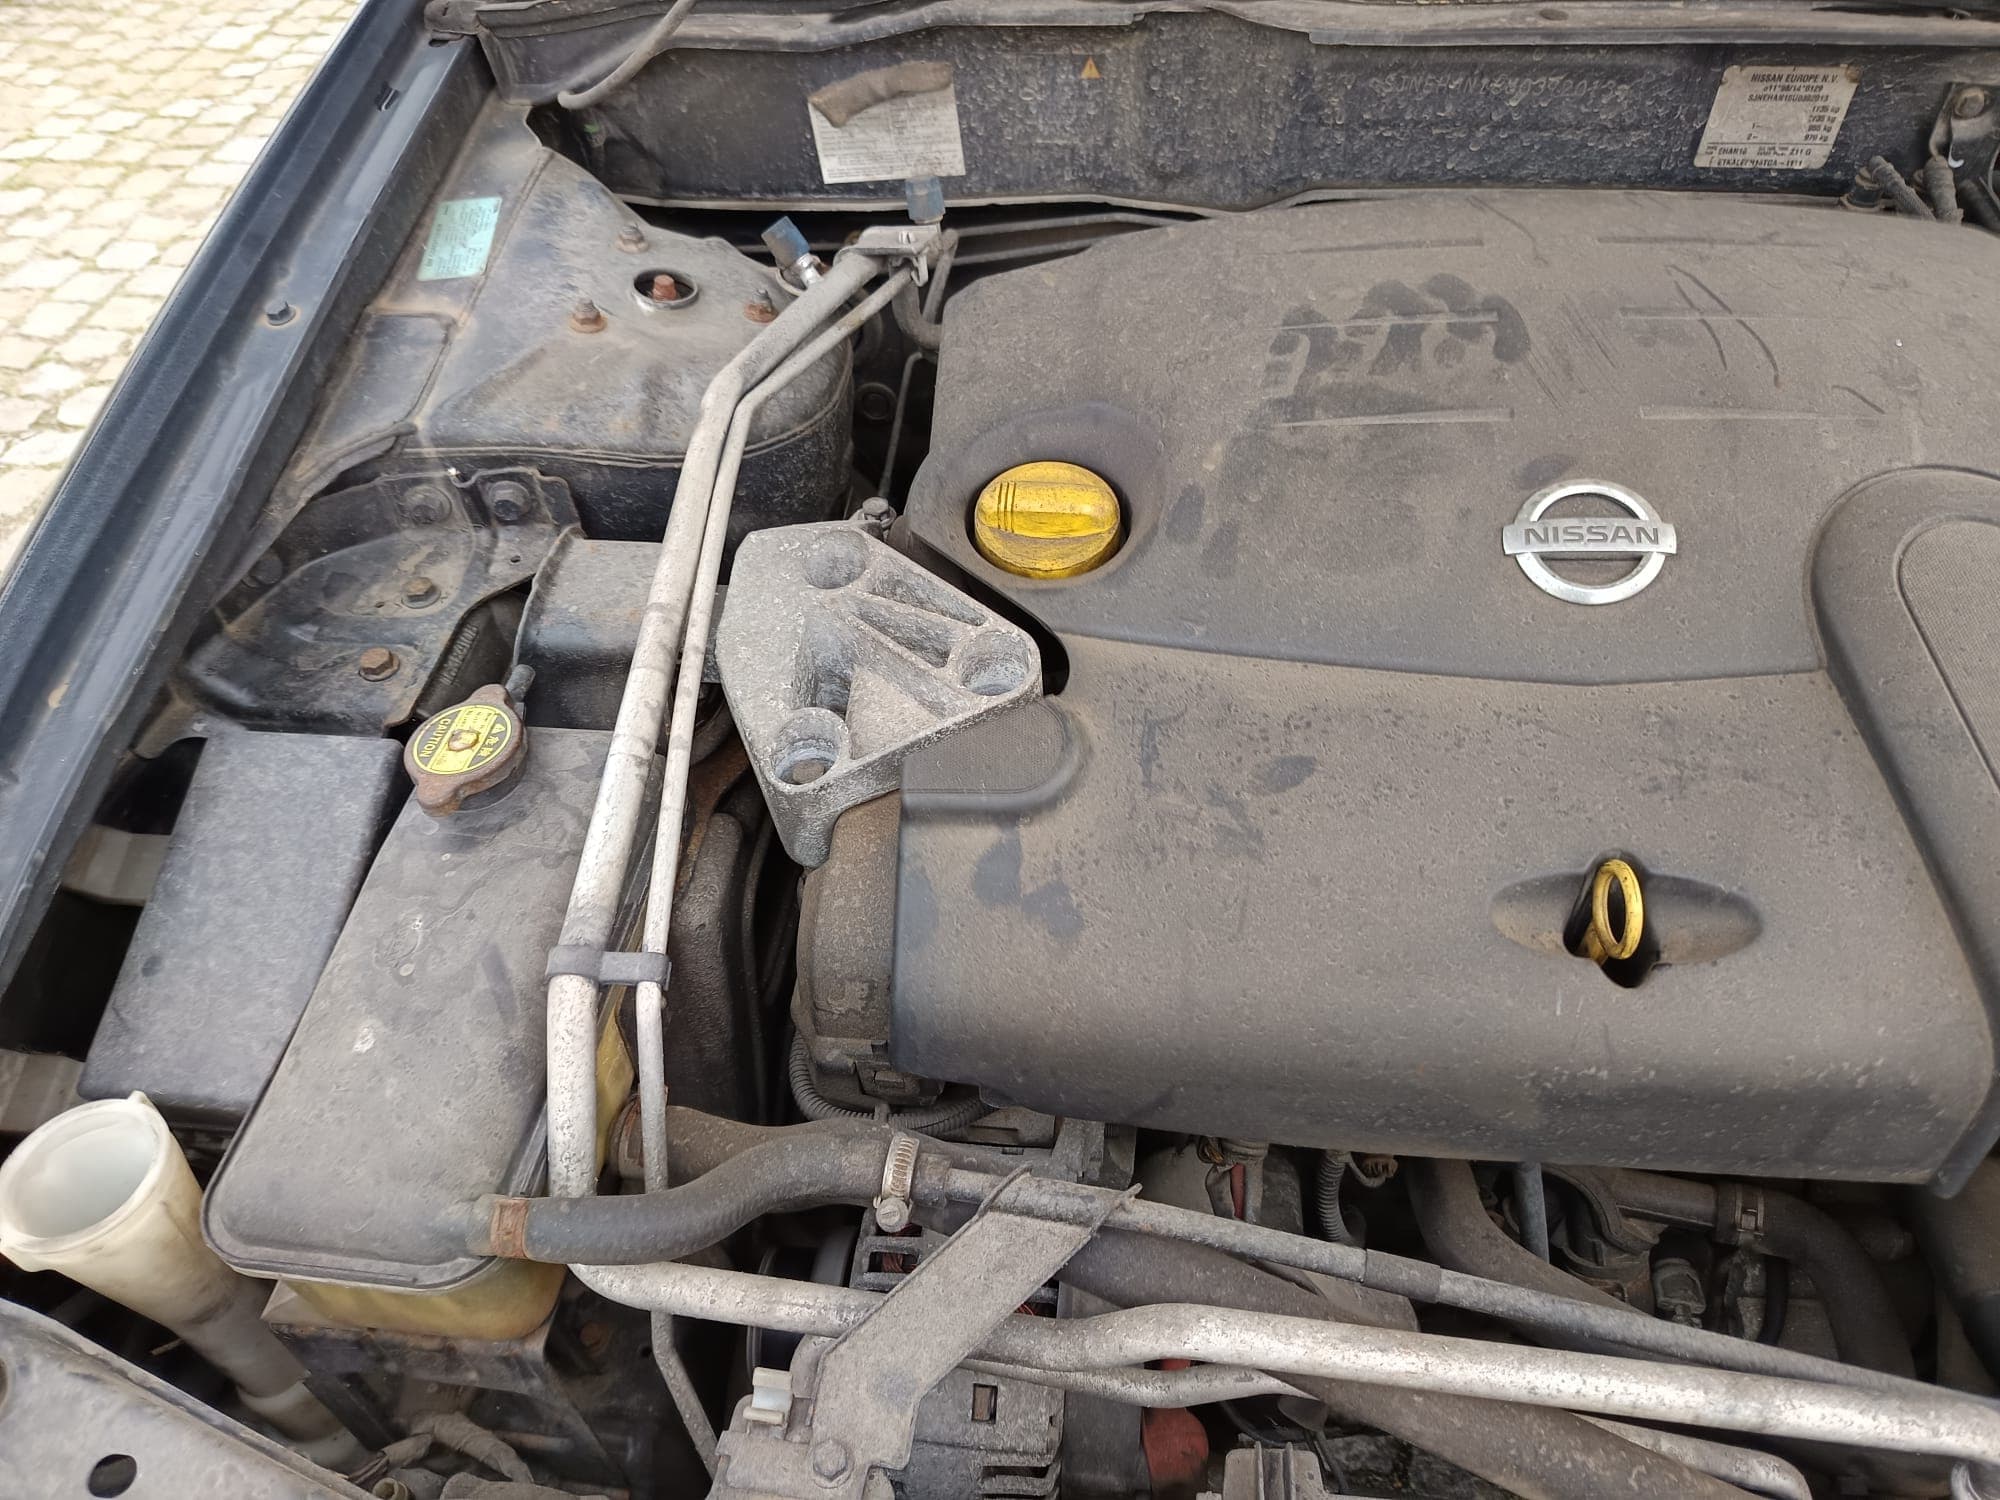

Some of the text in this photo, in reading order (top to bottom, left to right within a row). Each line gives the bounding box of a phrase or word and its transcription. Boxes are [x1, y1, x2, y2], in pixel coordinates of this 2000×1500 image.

[1751, 73, 1783, 82] NISSAN
[1785, 73, 1819, 83] EUROPE
[1523, 525, 1659, 545] NISSAN
[420, 718, 452, 758] CAUTION
